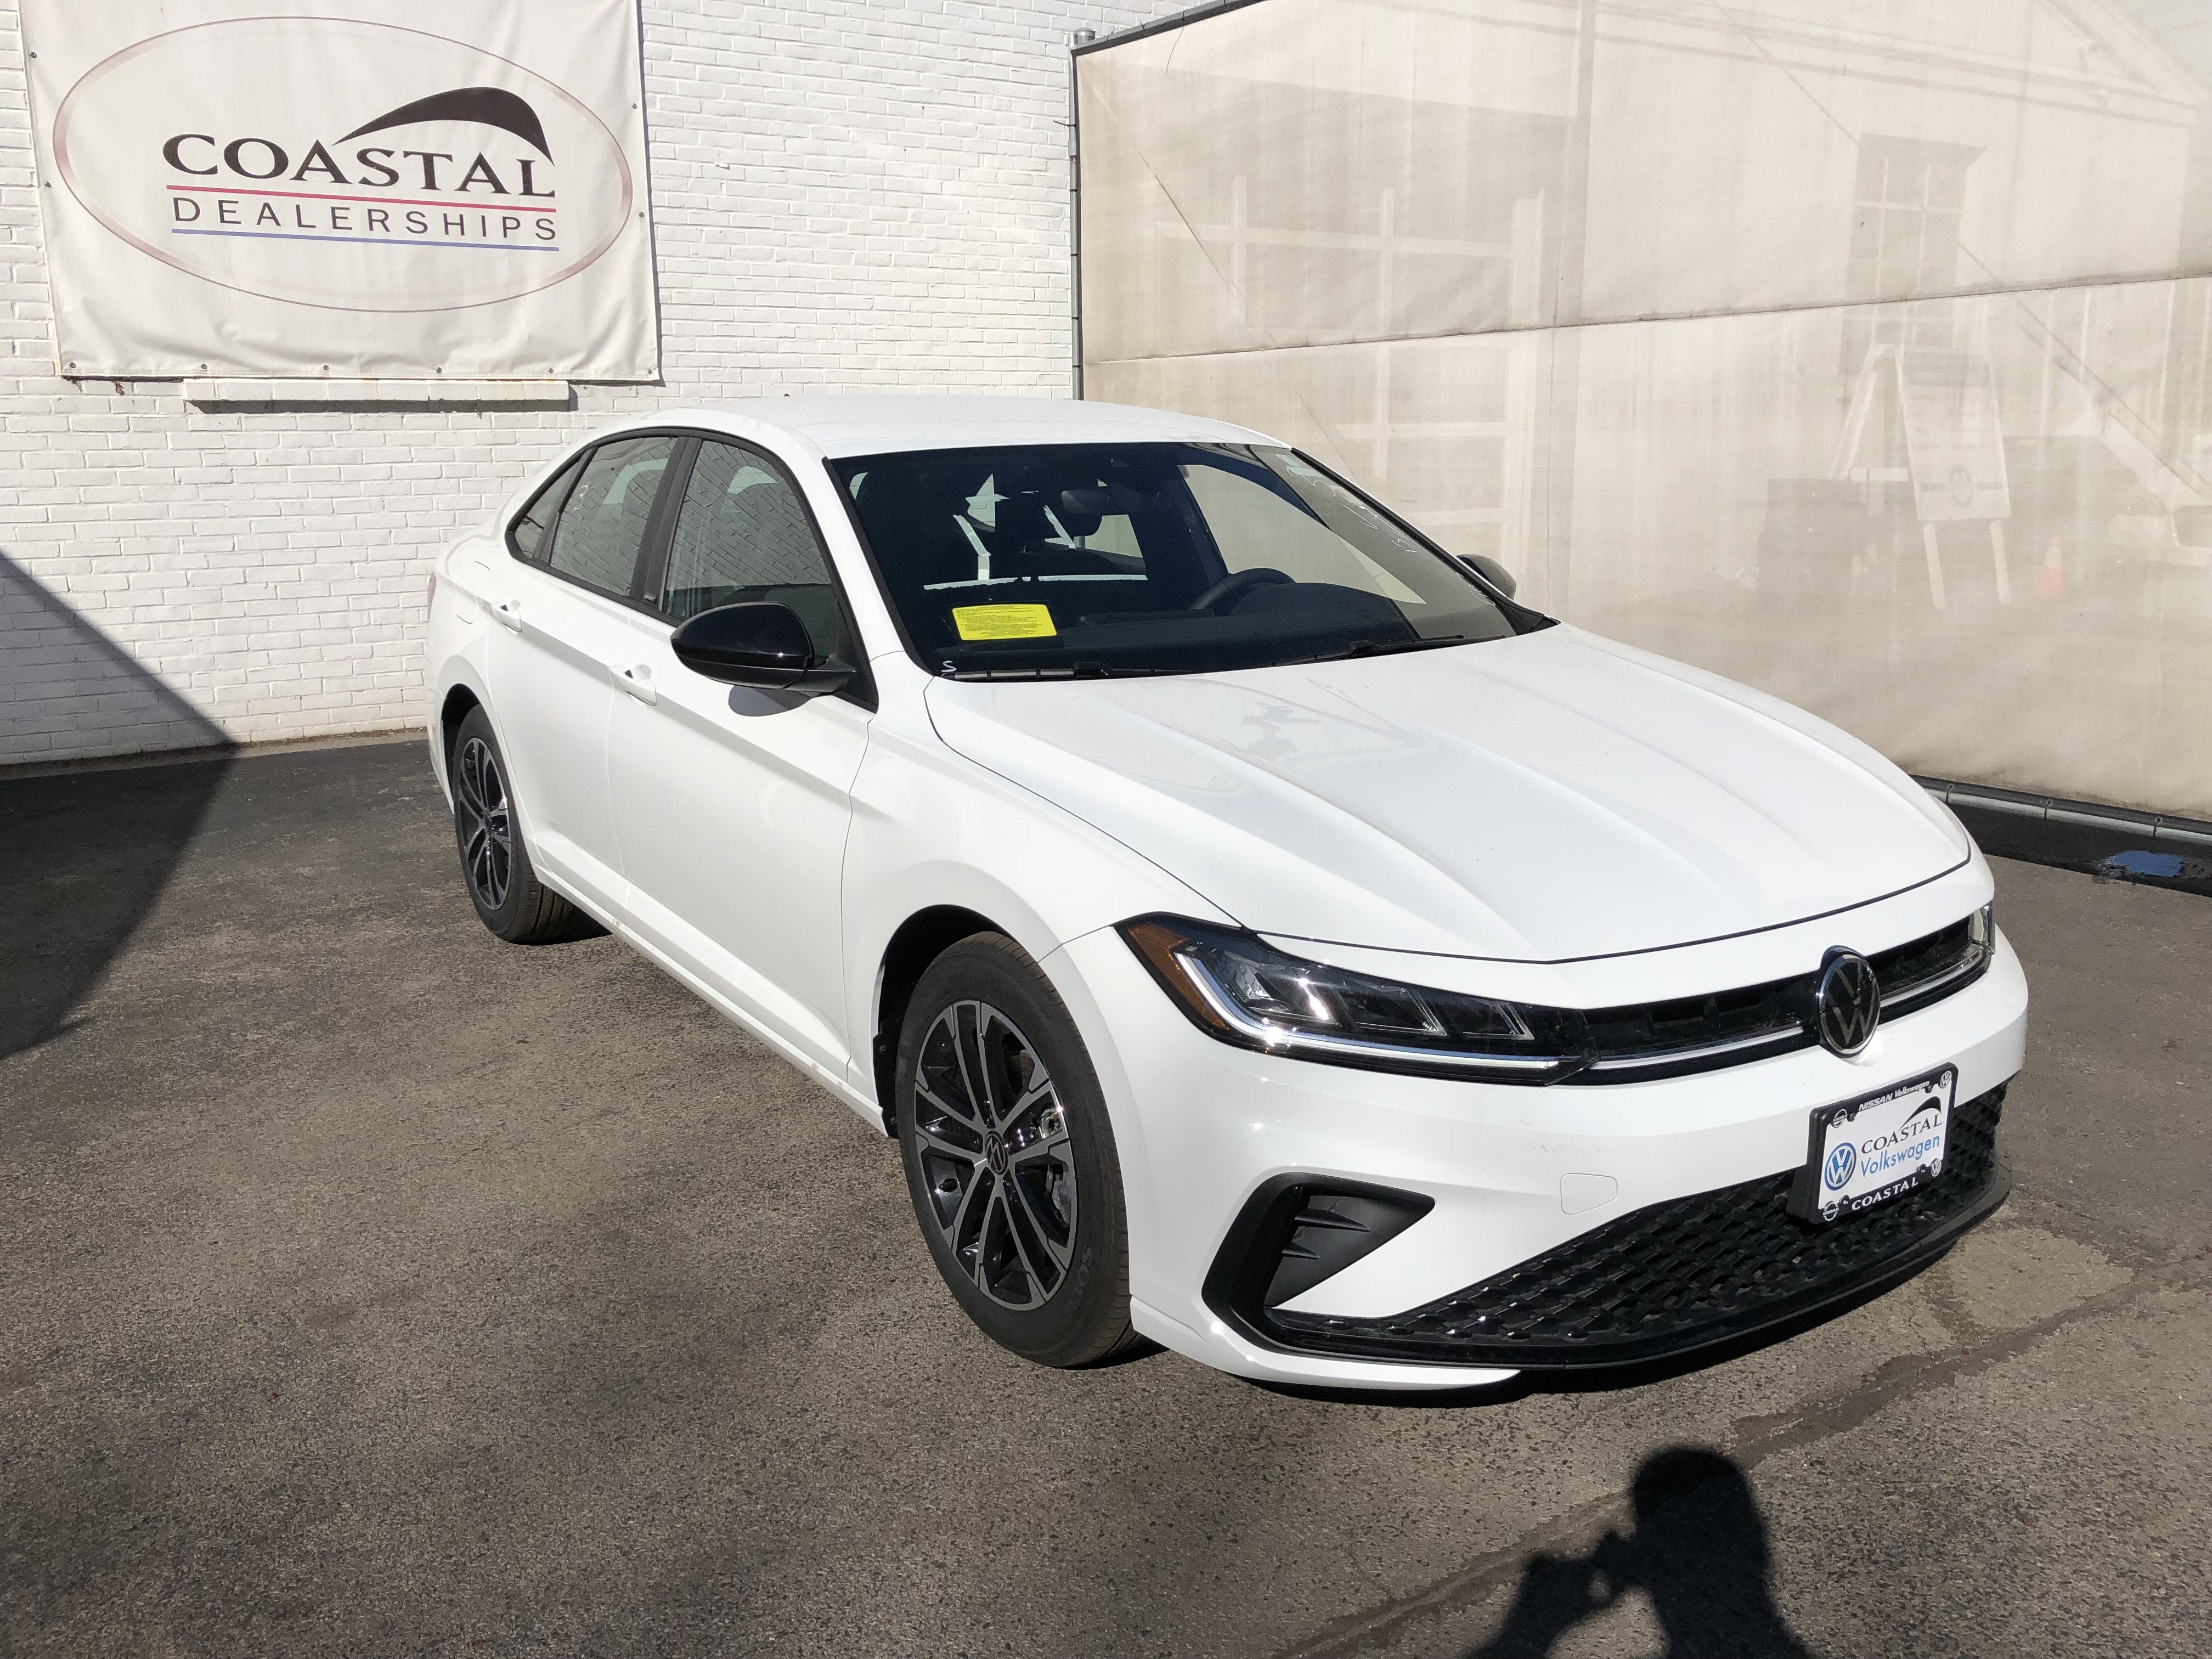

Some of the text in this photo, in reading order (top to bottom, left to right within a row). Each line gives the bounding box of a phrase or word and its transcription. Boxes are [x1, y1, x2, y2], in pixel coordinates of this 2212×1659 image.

[162, 133, 556, 198] COASTAL
[172, 196, 556, 240] DEALERSHIPS
[1858, 1080, 1930, 1111] NISSAN Volkswagen
[1861, 1114, 1942, 1154] COASTAL
[1860, 1136, 1940, 1177] Volkswagen
[1852, 1177, 1918, 1210] COASTAL
